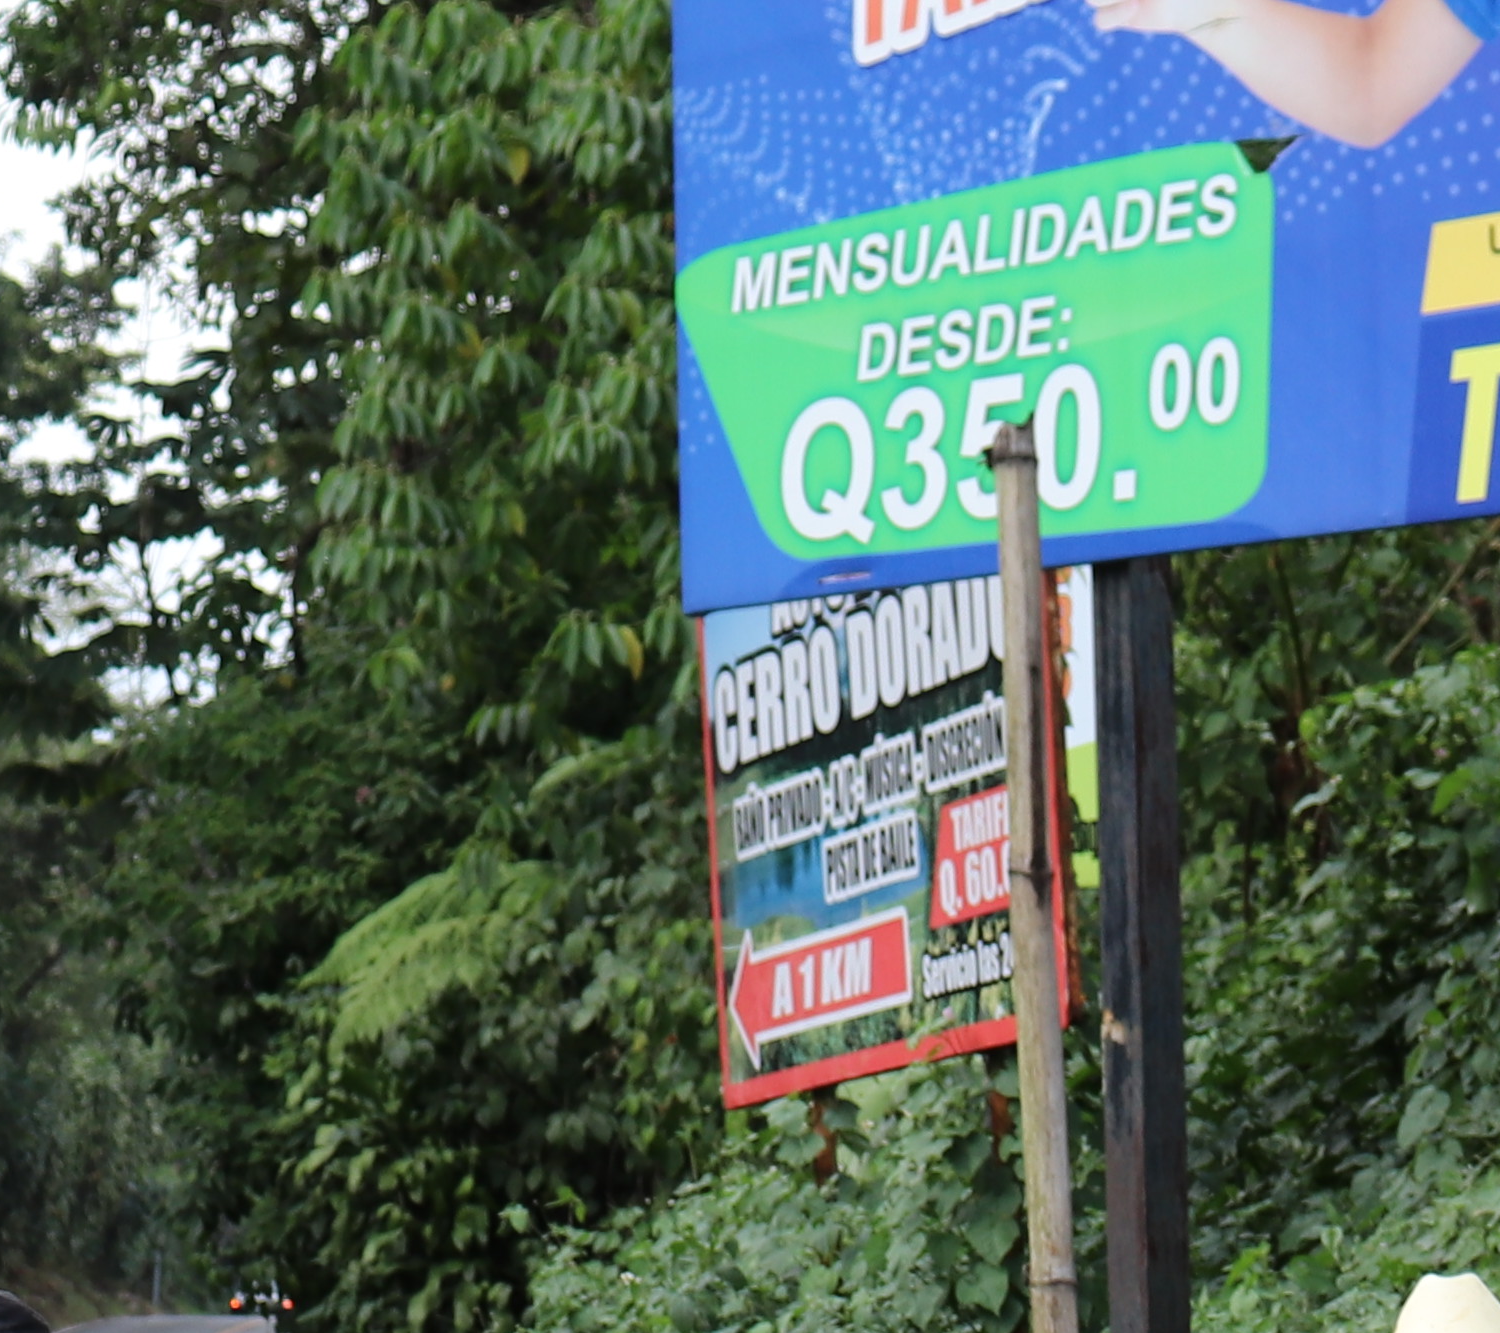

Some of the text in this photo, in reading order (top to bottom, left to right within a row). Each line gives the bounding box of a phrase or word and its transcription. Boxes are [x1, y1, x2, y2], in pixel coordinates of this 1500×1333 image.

[731, 173, 1238, 315] MENSUALIDADES
[857, 297, 1071, 383] DESDE:
[714, 623, 841, 774] CERRO
[772, 937, 873, 1019] A 1 KM
